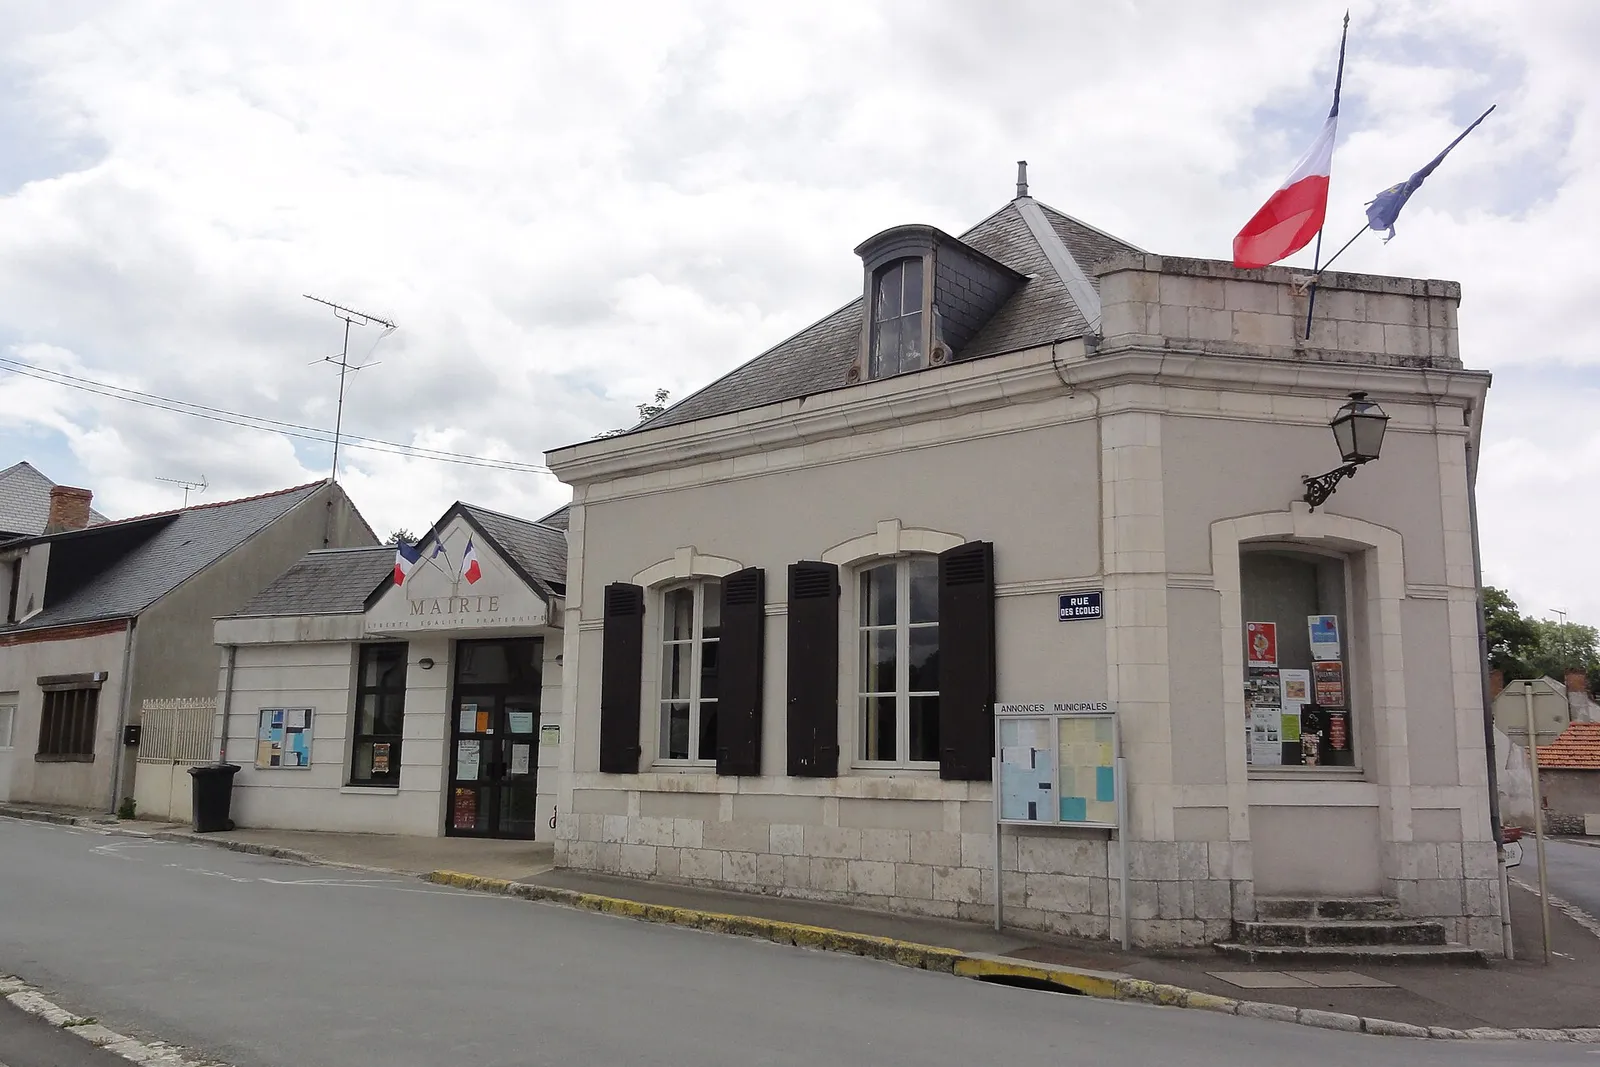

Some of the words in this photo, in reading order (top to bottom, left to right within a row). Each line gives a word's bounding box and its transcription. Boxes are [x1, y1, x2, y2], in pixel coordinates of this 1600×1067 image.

[410, 596, 499, 616] MAIRIE
[1070, 597, 1089, 606] RUE
[1060, 608, 1074, 617] DES
[1001, 704, 1045, 713] ANNONCES
[1053, 702, 1108, 712] MUNICIPALES
